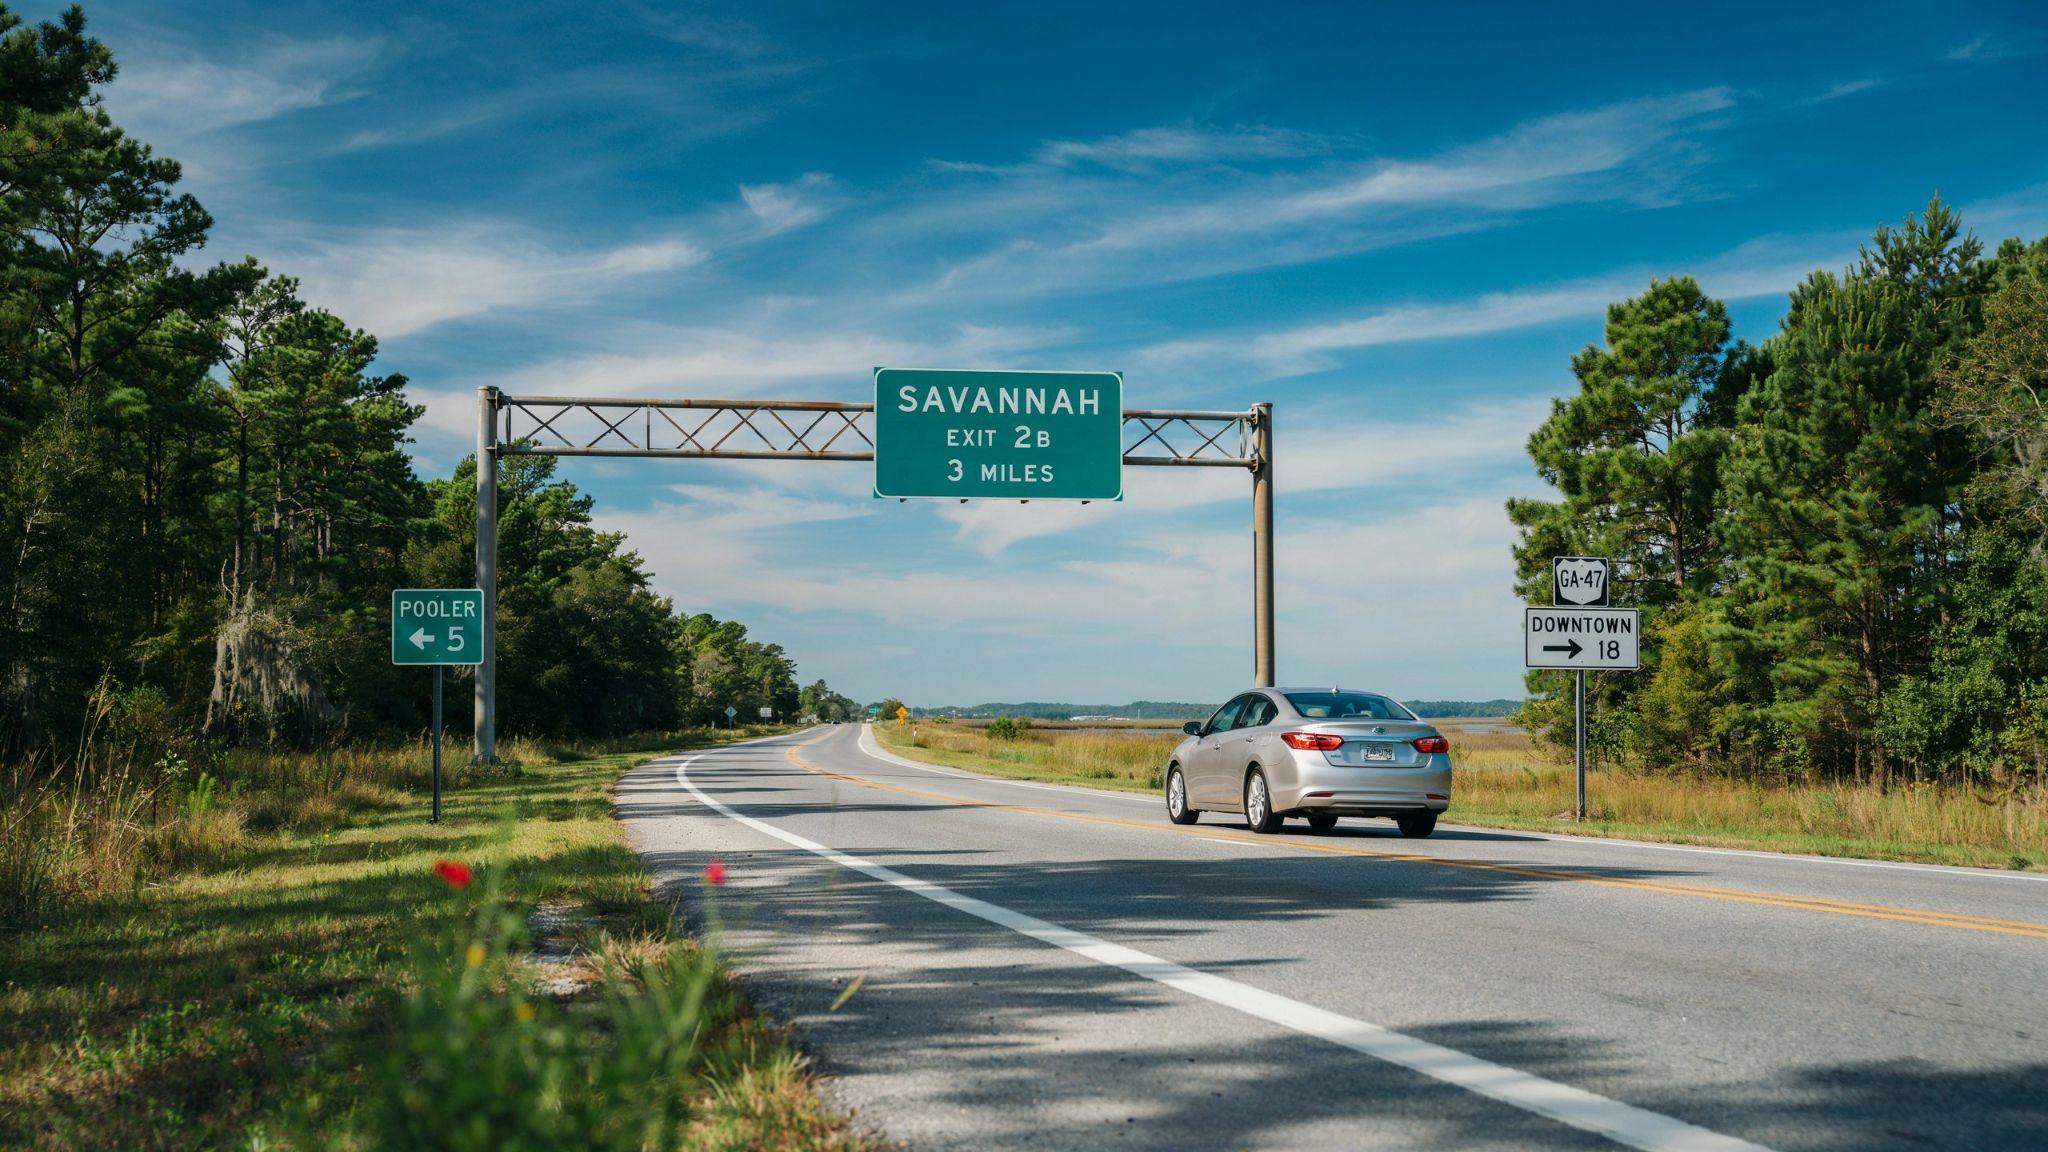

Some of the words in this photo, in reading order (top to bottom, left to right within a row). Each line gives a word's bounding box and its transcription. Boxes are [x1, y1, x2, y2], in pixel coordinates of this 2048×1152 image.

[898, 385, 1099, 415] SAVANNAH
[947, 429, 997, 447] EXIT
[1014, 425, 1050, 449] 2B
[947, 459, 963, 482] 3
[981, 464, 1054, 482] MILES
[1560, 570, 1602, 588] GA-47
[400, 600, 475, 617] POOLER
[1532, 616, 1631, 634] DOWNTOWN
[447, 626, 464, 651] 5
[1598, 640, 1620, 660] 18
